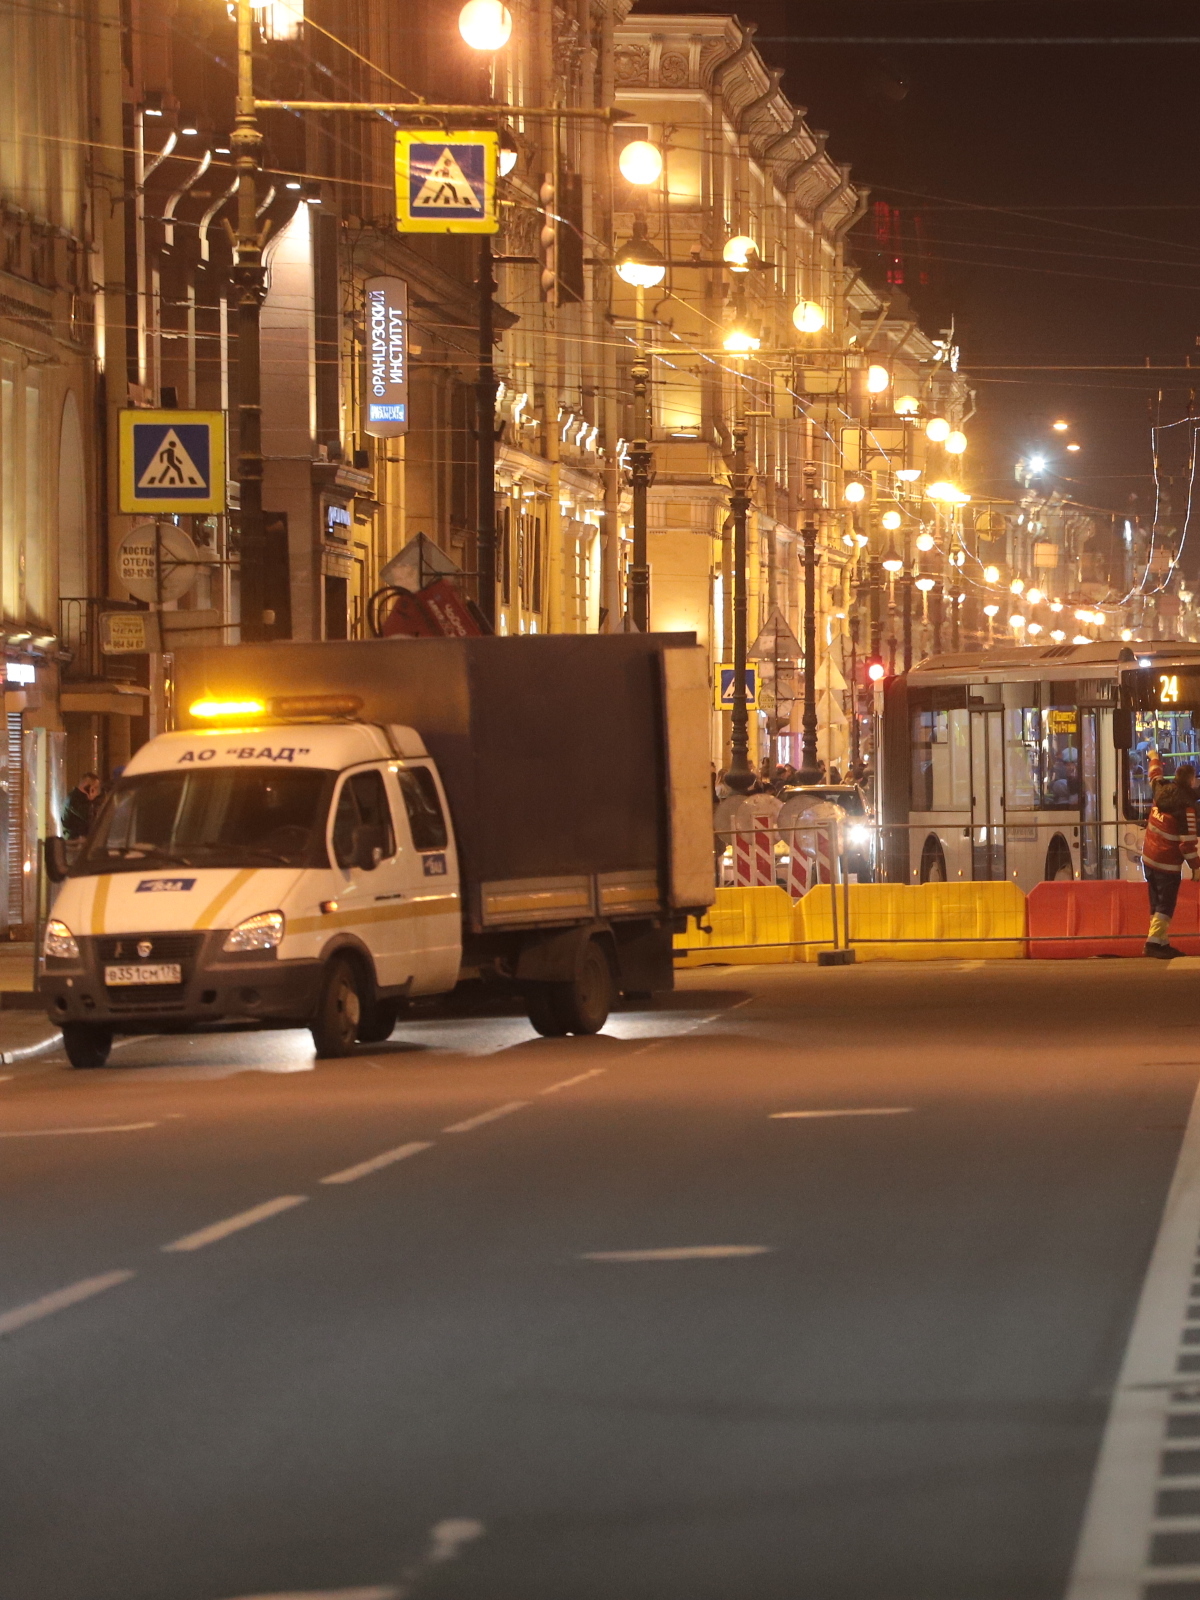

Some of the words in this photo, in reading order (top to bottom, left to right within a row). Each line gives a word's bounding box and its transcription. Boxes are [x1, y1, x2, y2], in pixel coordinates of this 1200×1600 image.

[369, 290, 387, 397] ФРАНЦУЗСКИЙ
[389, 307, 403, 383] ИНСТИТУТ
[371, 412, 404, 421] FRANÇAIS
[123, 557, 155, 567] ОТЕЛЬ
[1159, 675, 1179, 702] 24
[177, 749, 217, 763] АО
